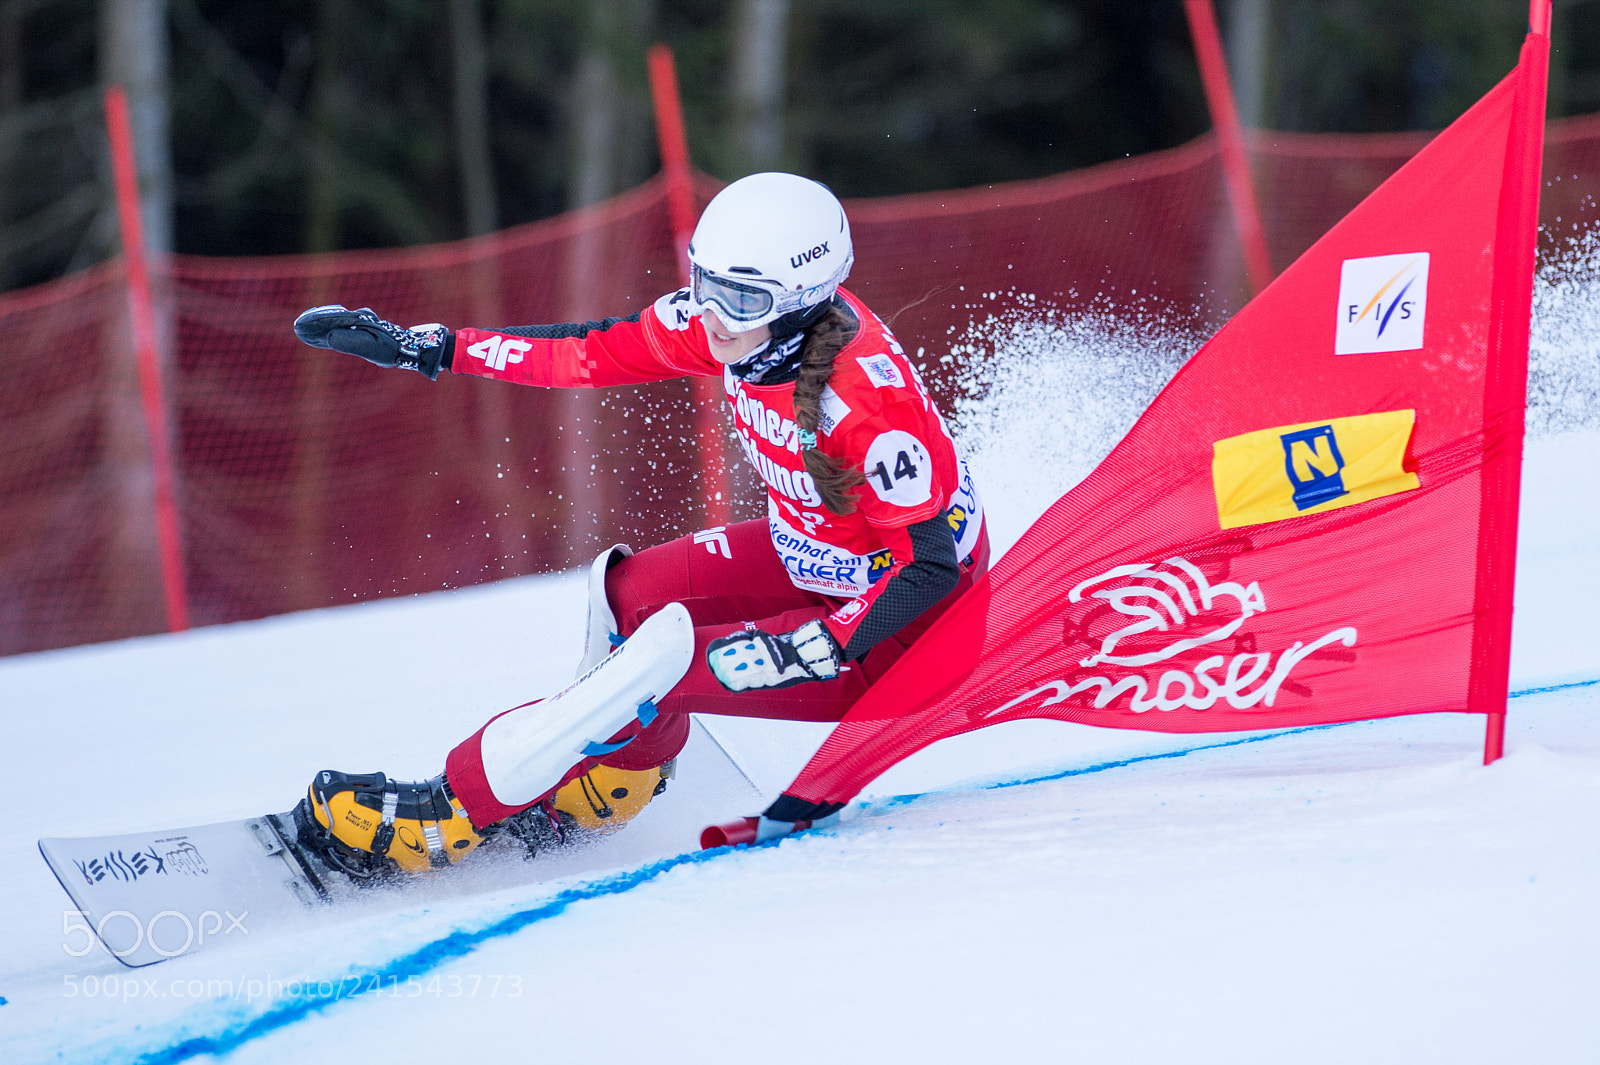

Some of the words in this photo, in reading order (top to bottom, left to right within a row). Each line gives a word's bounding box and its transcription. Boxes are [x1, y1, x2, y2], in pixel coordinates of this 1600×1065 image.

[790, 240, 831, 269] uvex
[1349, 301, 1411, 323] FIS
[466, 334, 533, 371] 4F
[876, 450, 918, 492] 14
[1289, 433, 1339, 483] N
[779, 550, 857, 584] CHER
[836, 581, 859, 593] alpin
[984, 626, 1356, 718] moser
